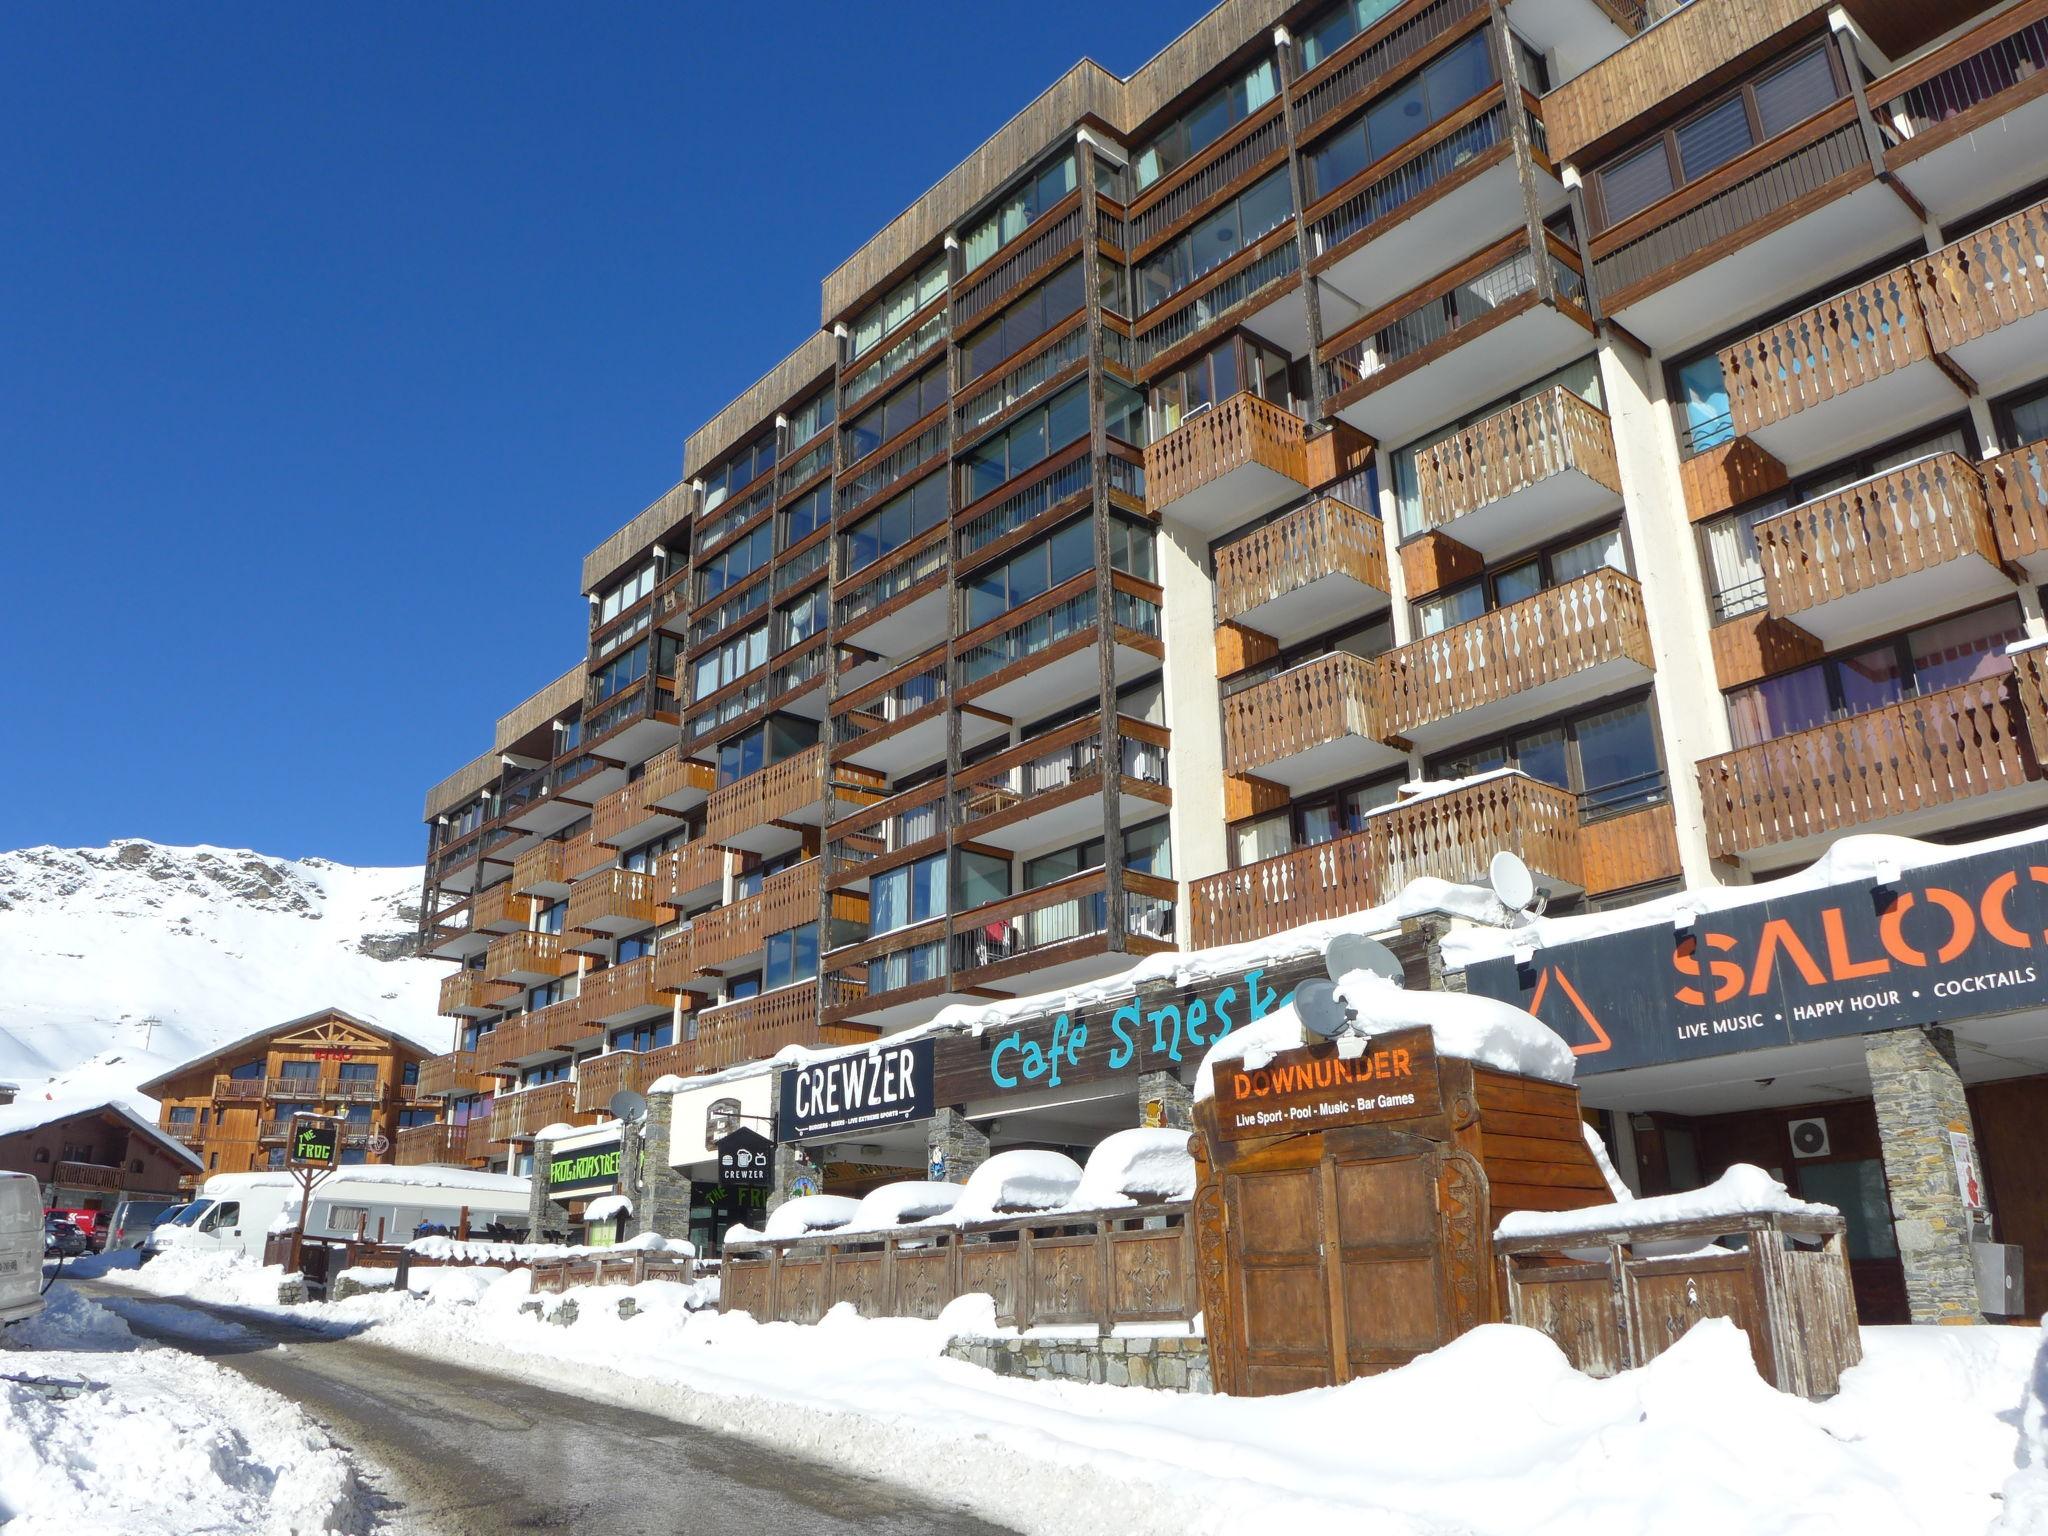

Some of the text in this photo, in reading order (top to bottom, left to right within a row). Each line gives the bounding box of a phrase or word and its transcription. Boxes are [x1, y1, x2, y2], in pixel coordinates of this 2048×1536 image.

[1672, 866, 2048, 1006] SALOO
[1108, 969, 1296, 1069] Snesk
[1677, 967, 2037, 1040] LIVE MUSIC HAPPY HOUR COCKTAILS
[795, 1048, 916, 1119] CREWZER
[1233, 1049, 1413, 1100] DOWNUNDER
[880, 1109, 899, 1120] SPORTS
[1236, 1093, 1416, 1127] Live Sport Pool Music Bar Games
[298, 1143, 331, 1159] FROG
[299, 1129, 317, 1144] THE
[724, 1170, 764, 1179] CREWZER
